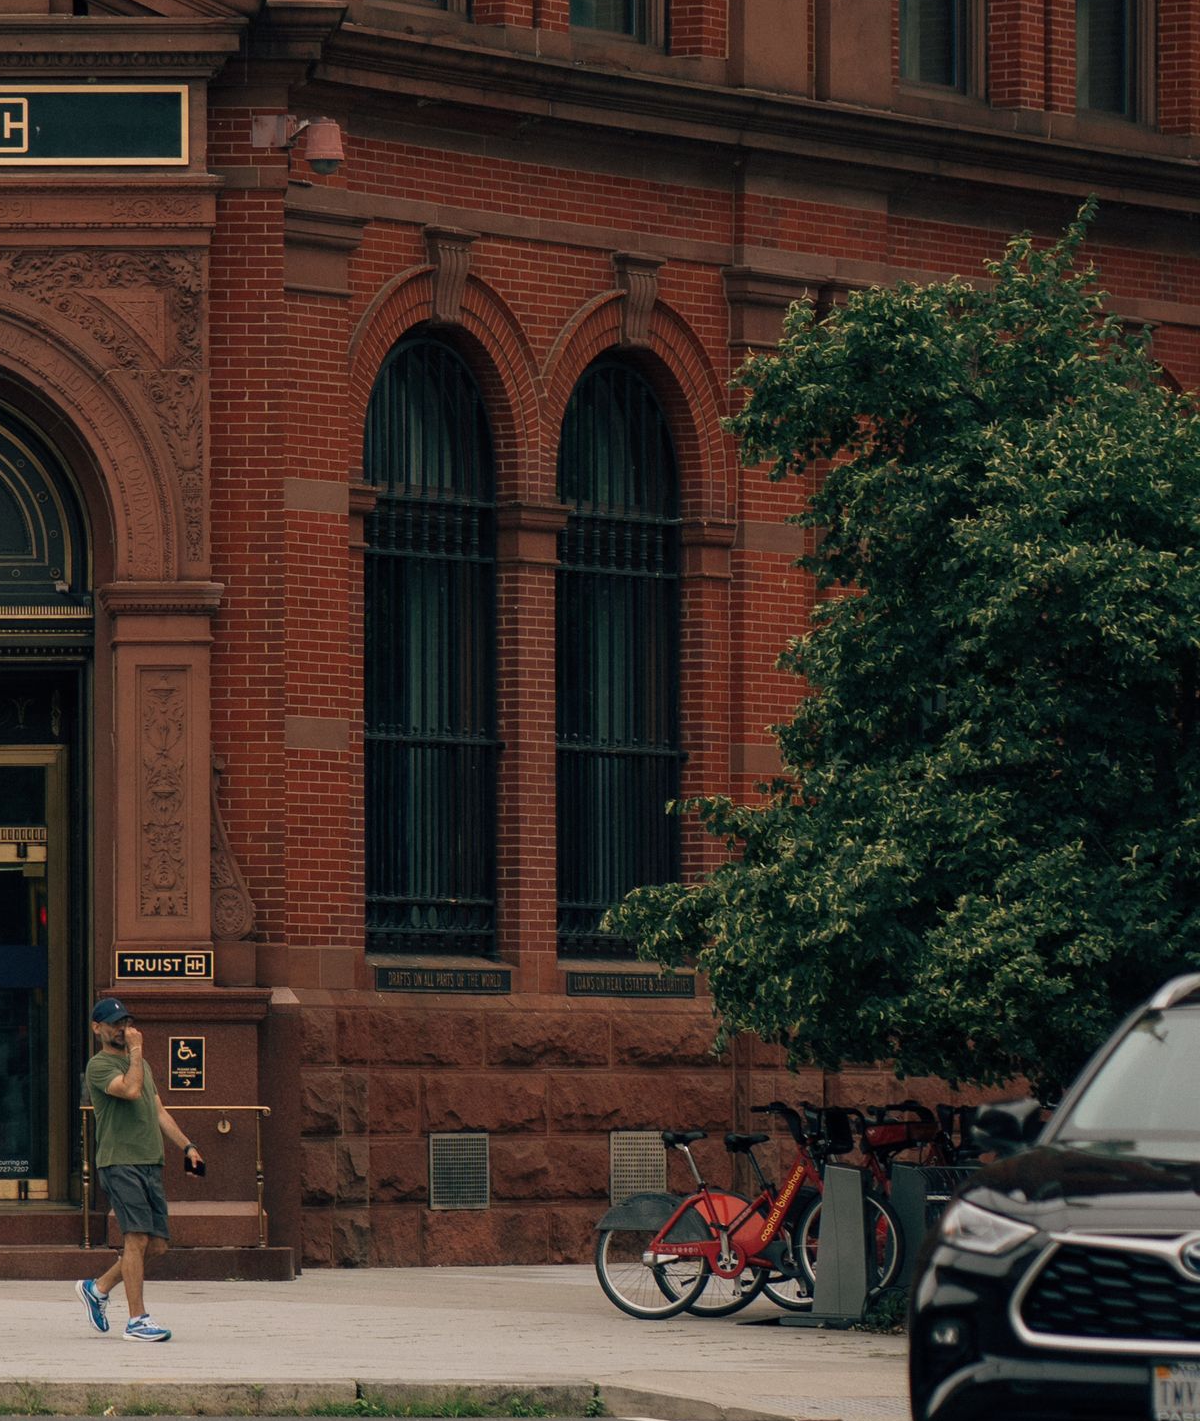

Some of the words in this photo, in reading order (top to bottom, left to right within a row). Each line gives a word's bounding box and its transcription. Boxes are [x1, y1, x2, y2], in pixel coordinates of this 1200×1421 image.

[41, 353, 86, 394] AND
[80, 388, 131, 450] TRUST
[119, 453, 155, 550] COMPANY
[124, 958, 183, 973] TRUIST
[388, 971, 411, 986] DRAFTS
[413, 972, 422, 986] ON
[424, 972, 434, 987] ALL
[436, 973, 454, 987] PARTS
[456, 973, 464, 987] OF
[467, 973, 478, 987] THE
[481, 973, 502, 987] WORLD
[574, 976, 594, 990] LOANS
[596, 977, 605, 991] ON
[606, 977, 623, 991] REAL
[624, 977, 647, 992] ESTATE
[648, 977, 654, 991] &
[761, 1208, 781, 1242] capital
[776, 1165, 805, 1208] bikeshare
